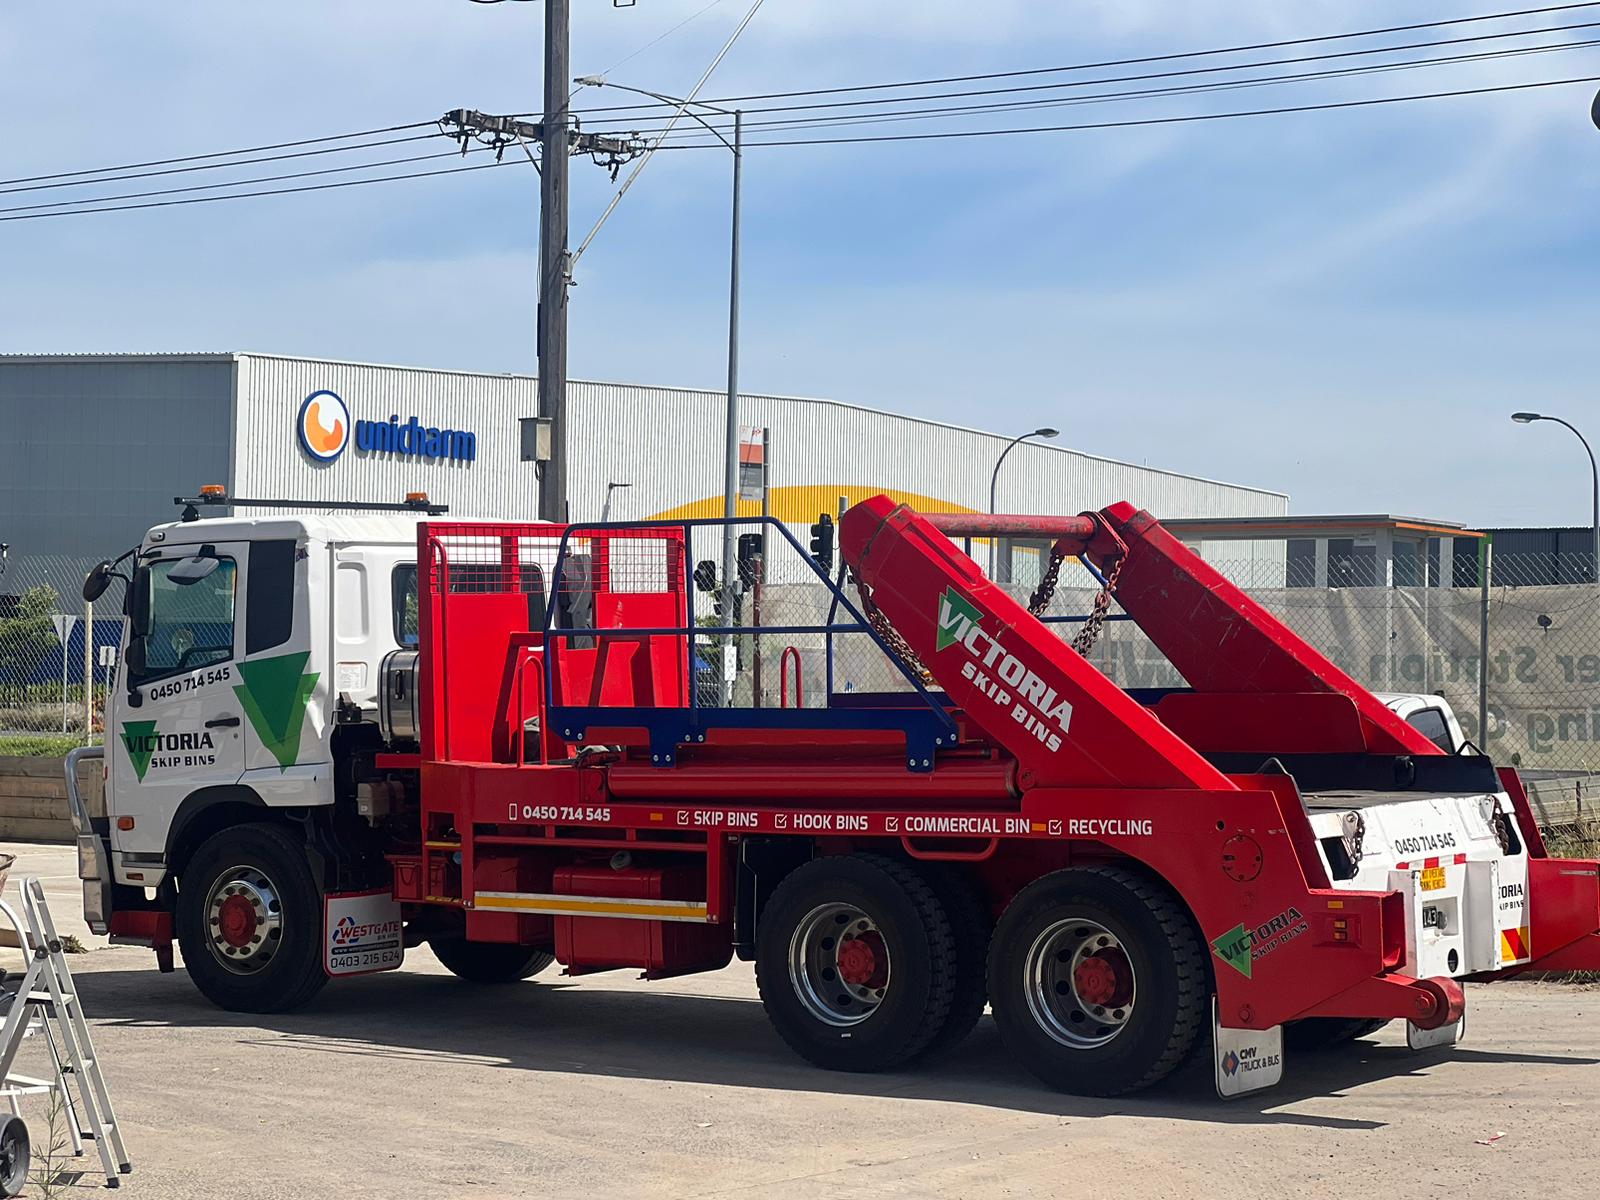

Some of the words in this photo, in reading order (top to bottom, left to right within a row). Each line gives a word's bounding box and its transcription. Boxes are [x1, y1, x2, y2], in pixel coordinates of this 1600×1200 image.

[355, 414, 476, 462] unicharm
[938, 599, 1074, 734] VICTORIA
[150, 681, 181, 701] 0450
[184, 674, 205, 692] 714
[207, 667, 230, 685] 545
[960, 661, 1012, 706] SKIP
[1010, 703, 1062, 753] BINS
[126, 732, 214, 753] VICTORIA
[151, 758, 181, 769] SKIP
[185, 754, 215, 766] BINS
[523, 805, 558, 821] 0450
[560, 806, 584, 821] 714
[586, 808, 611, 822] 545
[694, 811, 724, 826] SKIP
[727, 812, 759, 827] BINS
[793, 813, 832, 830] HOOK
[836, 815, 868, 831] BINS
[905, 816, 1001, 834] COMMERCIAL
[1068, 818, 1152, 836] RECYCLING
[1394, 836, 1421, 855] 0450
[1420, 834, 1437, 852] 714
[1438, 832, 1456, 849] 545
[340, 921, 400, 939] WESTGATE
[1220, 906, 1303, 962] VICTORIA
[1251, 939, 1279, 961] SKIP
[1281, 921, 1308, 943] BINS
[331, 956, 360, 969] 0403
[363, 952, 380, 965] 215
[382, 951, 400, 962] 624
[1239, 1047, 1257, 1060] CMV
[1240, 1057, 1262, 1072] TRUCK
[1262, 1056, 1268, 1067] &
[1268, 1054, 1280, 1067] BUS
